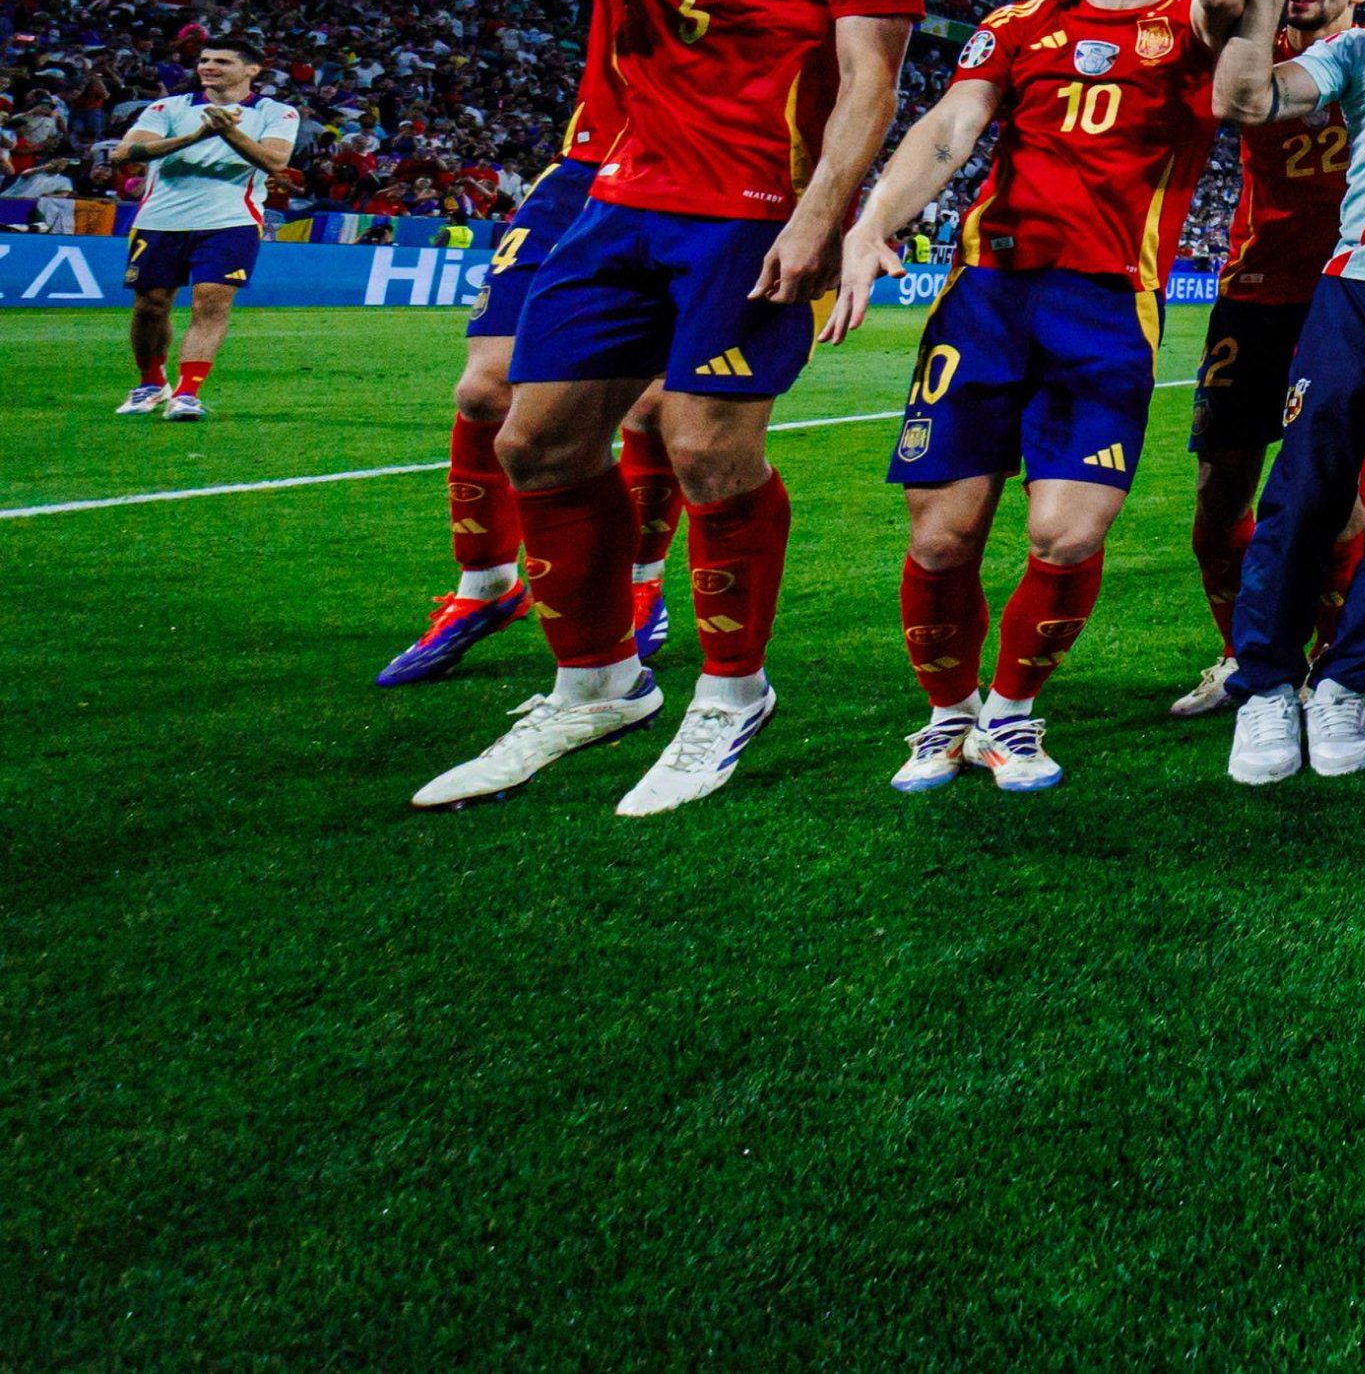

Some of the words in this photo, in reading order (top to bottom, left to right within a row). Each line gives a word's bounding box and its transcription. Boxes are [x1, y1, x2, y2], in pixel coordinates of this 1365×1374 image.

[1057, 81, 1122, 135] 10
[1282, 126, 1349, 179] 22
[131, 239, 148, 262] 7
[491, 228, 531, 275] 4
[899, 272, 949, 305] gor
[1198, 337, 1238, 388] 2
